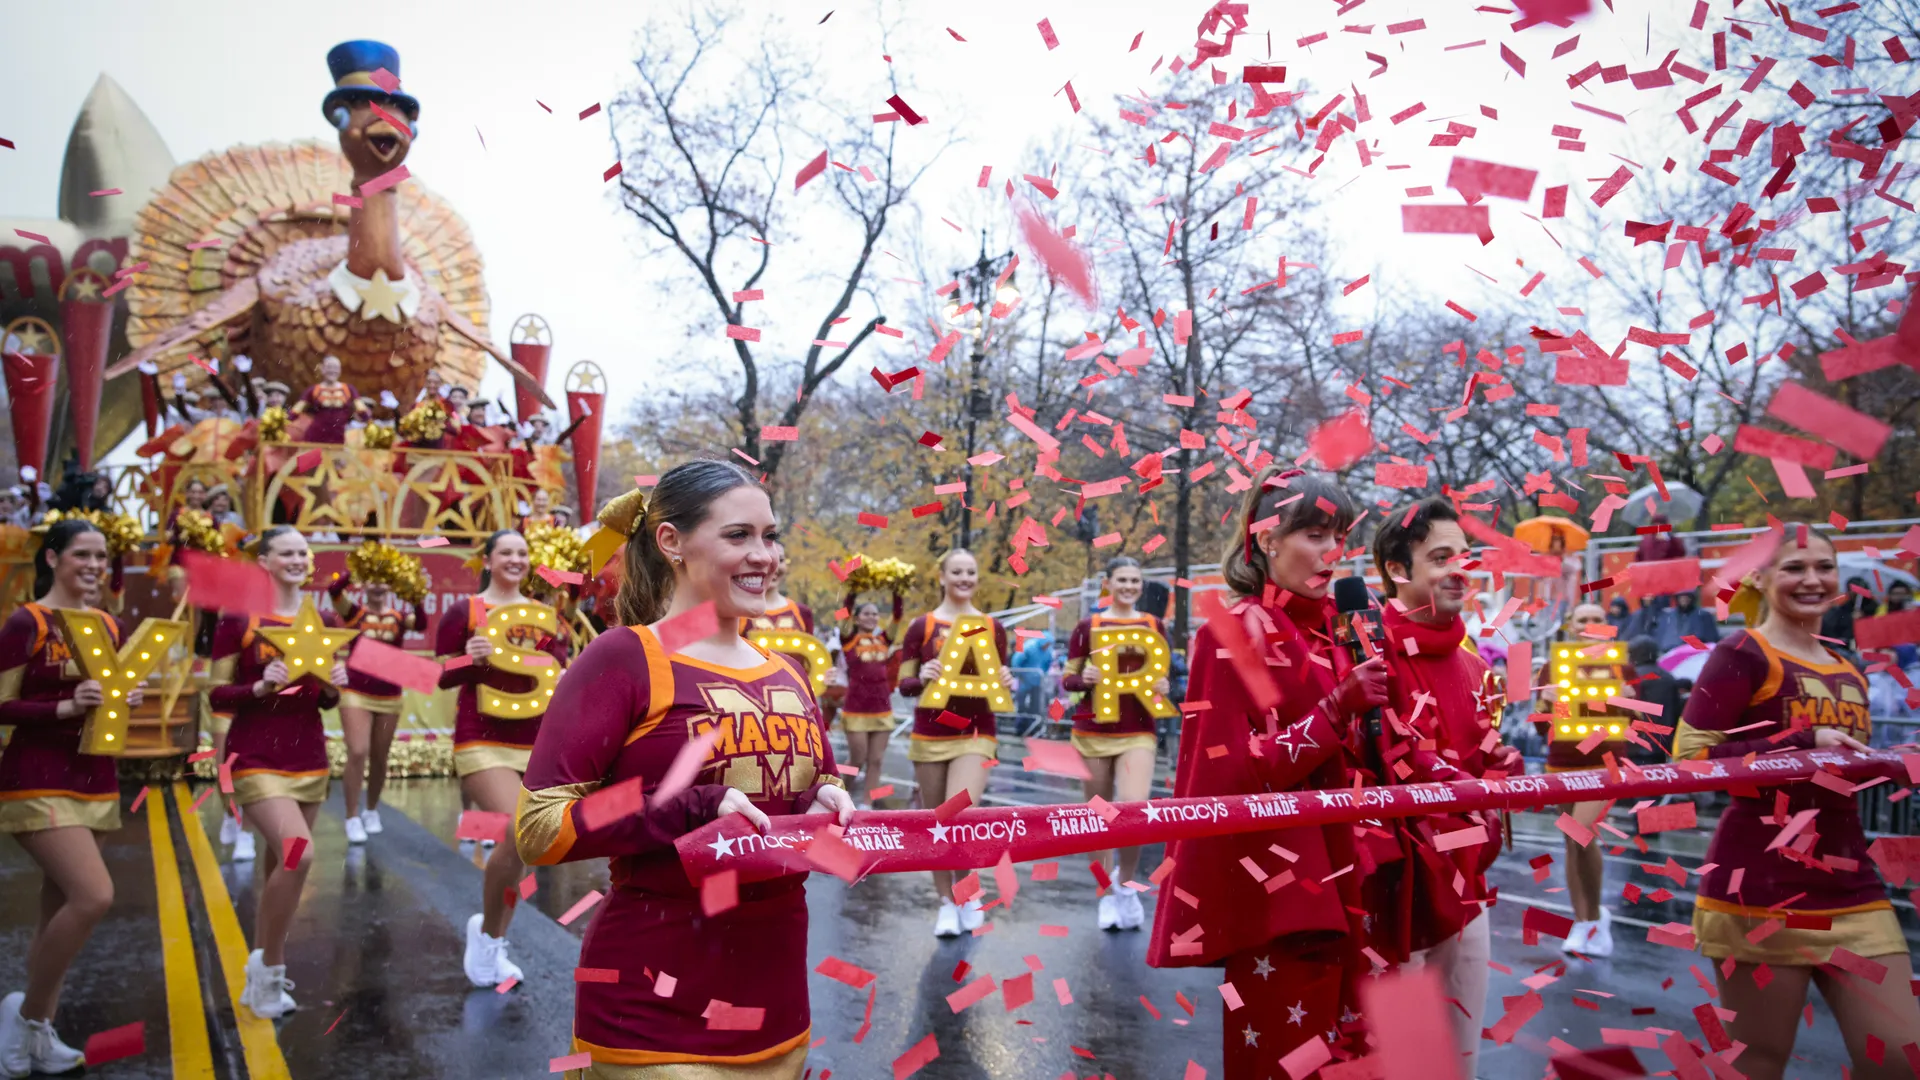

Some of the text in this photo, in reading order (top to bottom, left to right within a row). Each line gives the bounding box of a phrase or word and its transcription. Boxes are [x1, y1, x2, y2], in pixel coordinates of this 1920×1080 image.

[53, 609, 189, 756] Y
[476, 602, 563, 720] S
[918, 614, 1015, 713] A
[1090, 625, 1179, 724] R
[1550, 642, 1630, 742] E
[1790, 697, 1872, 736] MACY
[953, 811, 1027, 843] macy's
[1051, 815, 1109, 837] PARADE
[1163, 797, 1229, 823] macy's
[1334, 786, 1394, 809] mcy's
